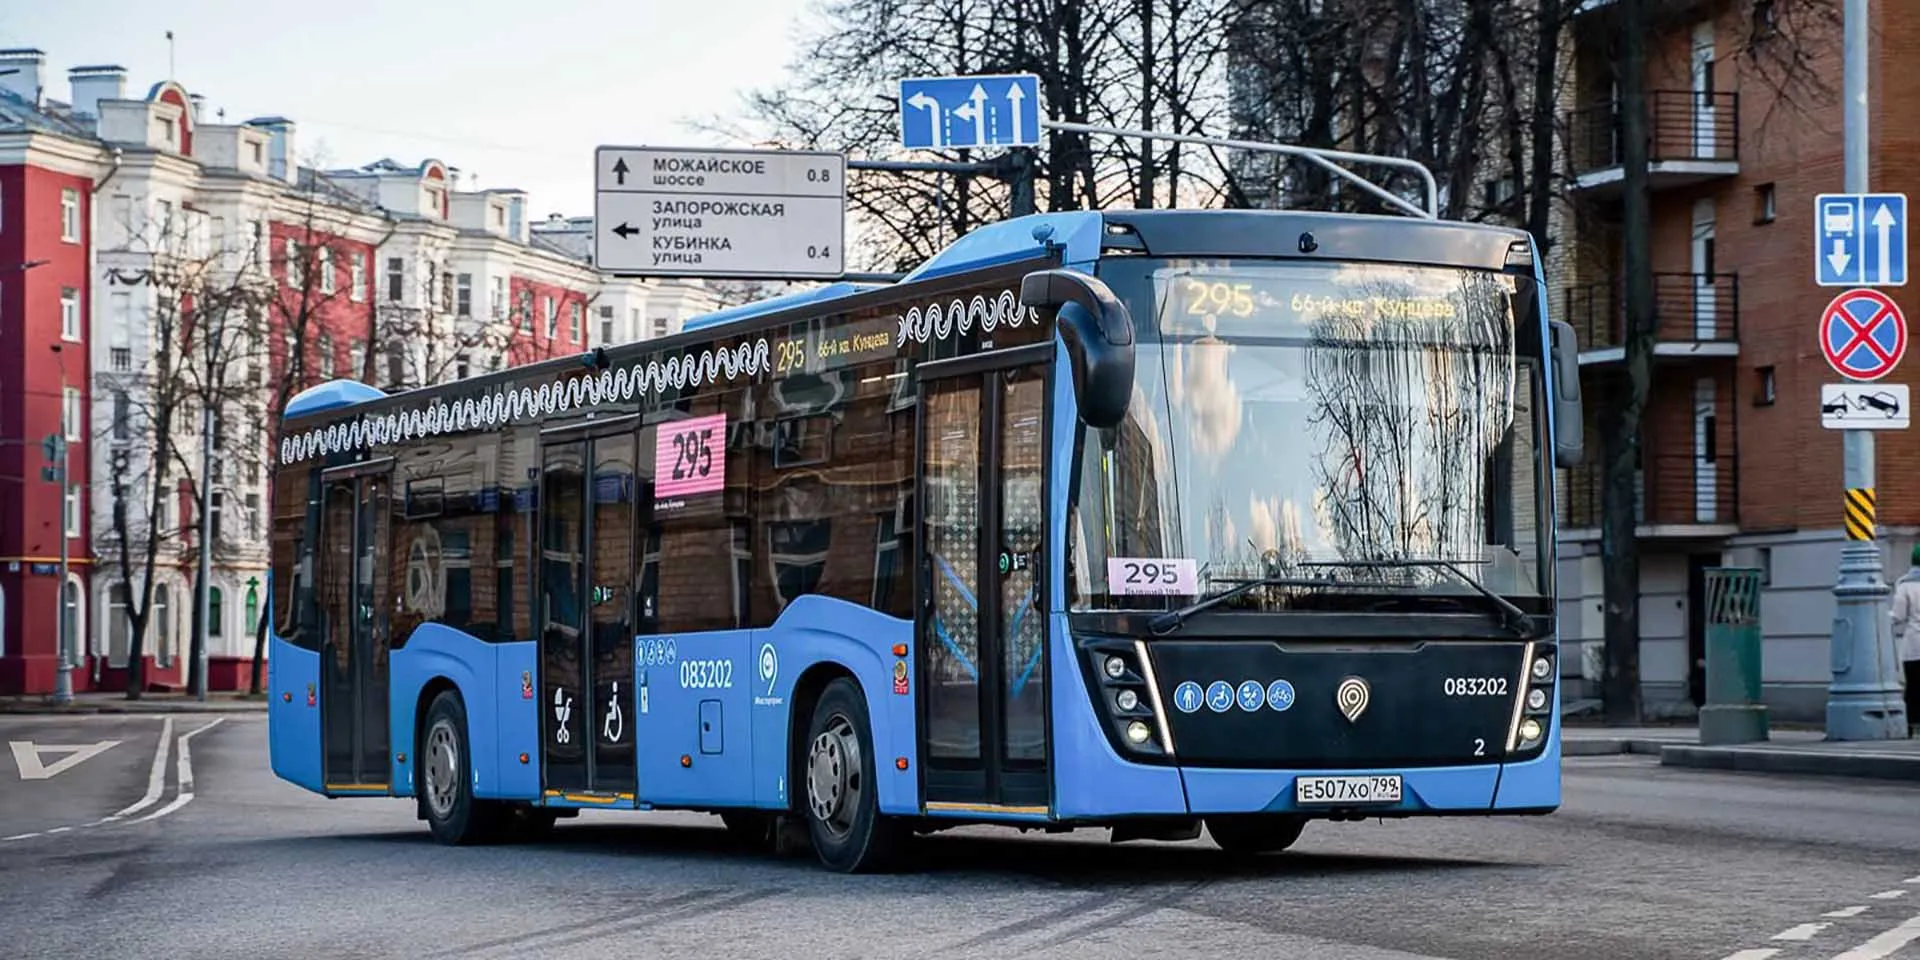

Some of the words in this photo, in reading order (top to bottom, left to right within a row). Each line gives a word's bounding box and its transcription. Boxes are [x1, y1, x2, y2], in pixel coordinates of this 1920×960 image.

[653, 157, 765, 174] МОЖАЙСКОЕ
[653, 175, 705, 186] шоссе
[807, 169, 830, 182] 0.8
[652, 201, 784, 216] ЗАПОРОЖСКАЯ
[652, 217, 702, 229] улица
[653, 236, 732, 250] КУБИНКА
[652, 252, 702, 265] улица
[807, 246, 830, 259] 0.4
[1187, 281, 1254, 318] 295
[777, 339, 805, 372] 295
[672, 429, 712, 480] 295
[1124, 563, 1178, 584] 295
[680, 659, 732, 688] 083202
[1444, 678, 1507, 695] 083202
[1474, 738, 1485, 756] 2
[1371, 778, 1396, 792] 799
